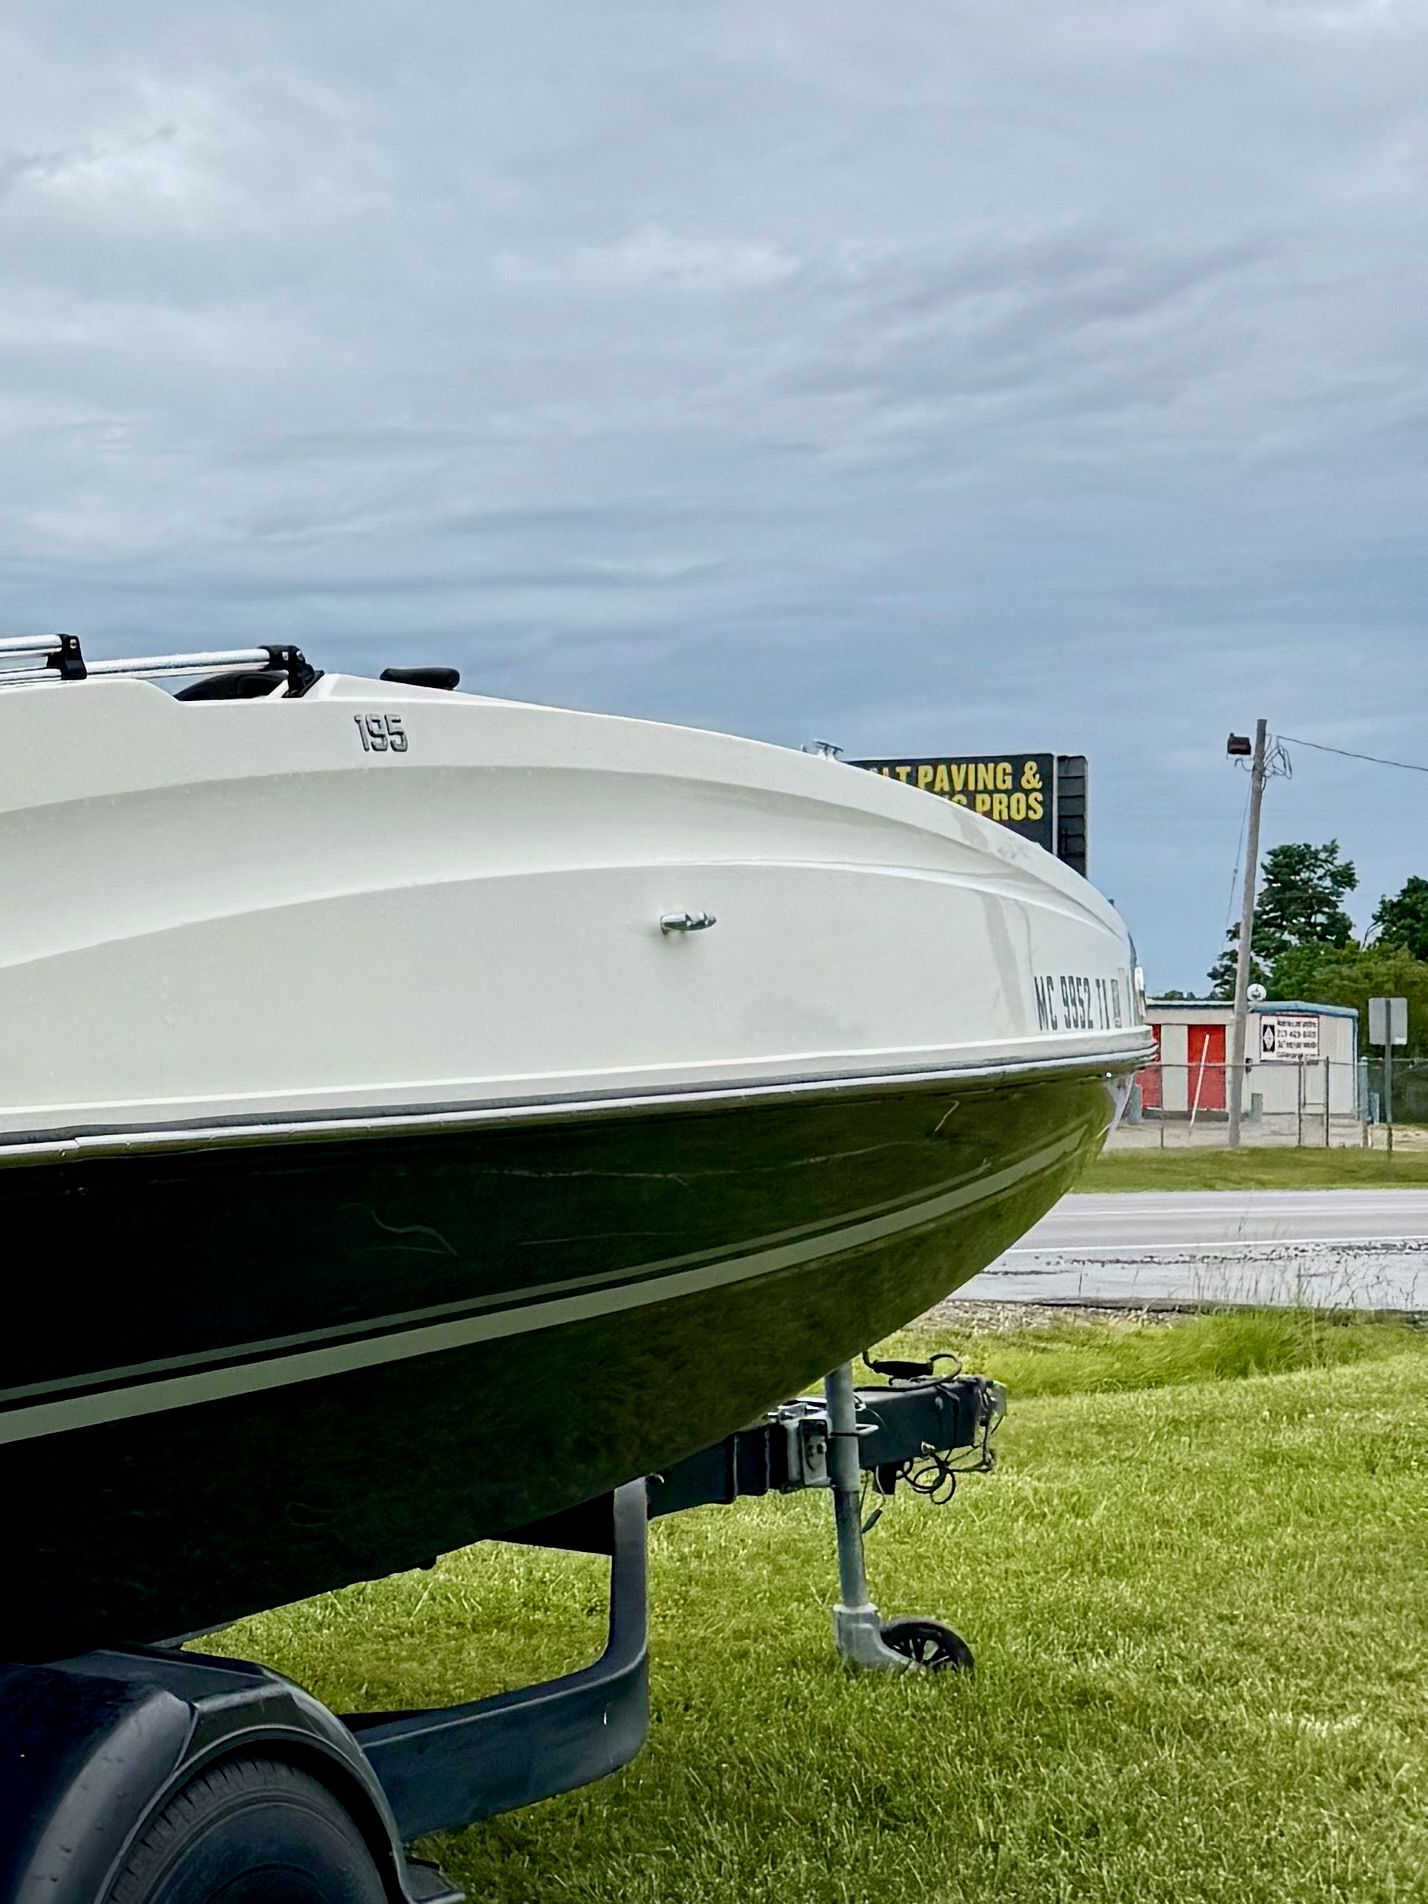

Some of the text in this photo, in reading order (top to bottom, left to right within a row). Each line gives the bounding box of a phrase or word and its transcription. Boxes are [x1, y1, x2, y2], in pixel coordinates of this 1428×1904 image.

[354, 714, 408, 752] 195
[918, 761, 1012, 792] PAVING
[1021, 761, 1043, 790] &
[975, 792, 1044, 822] PROS
[1034, 975, 1058, 1031] MC
